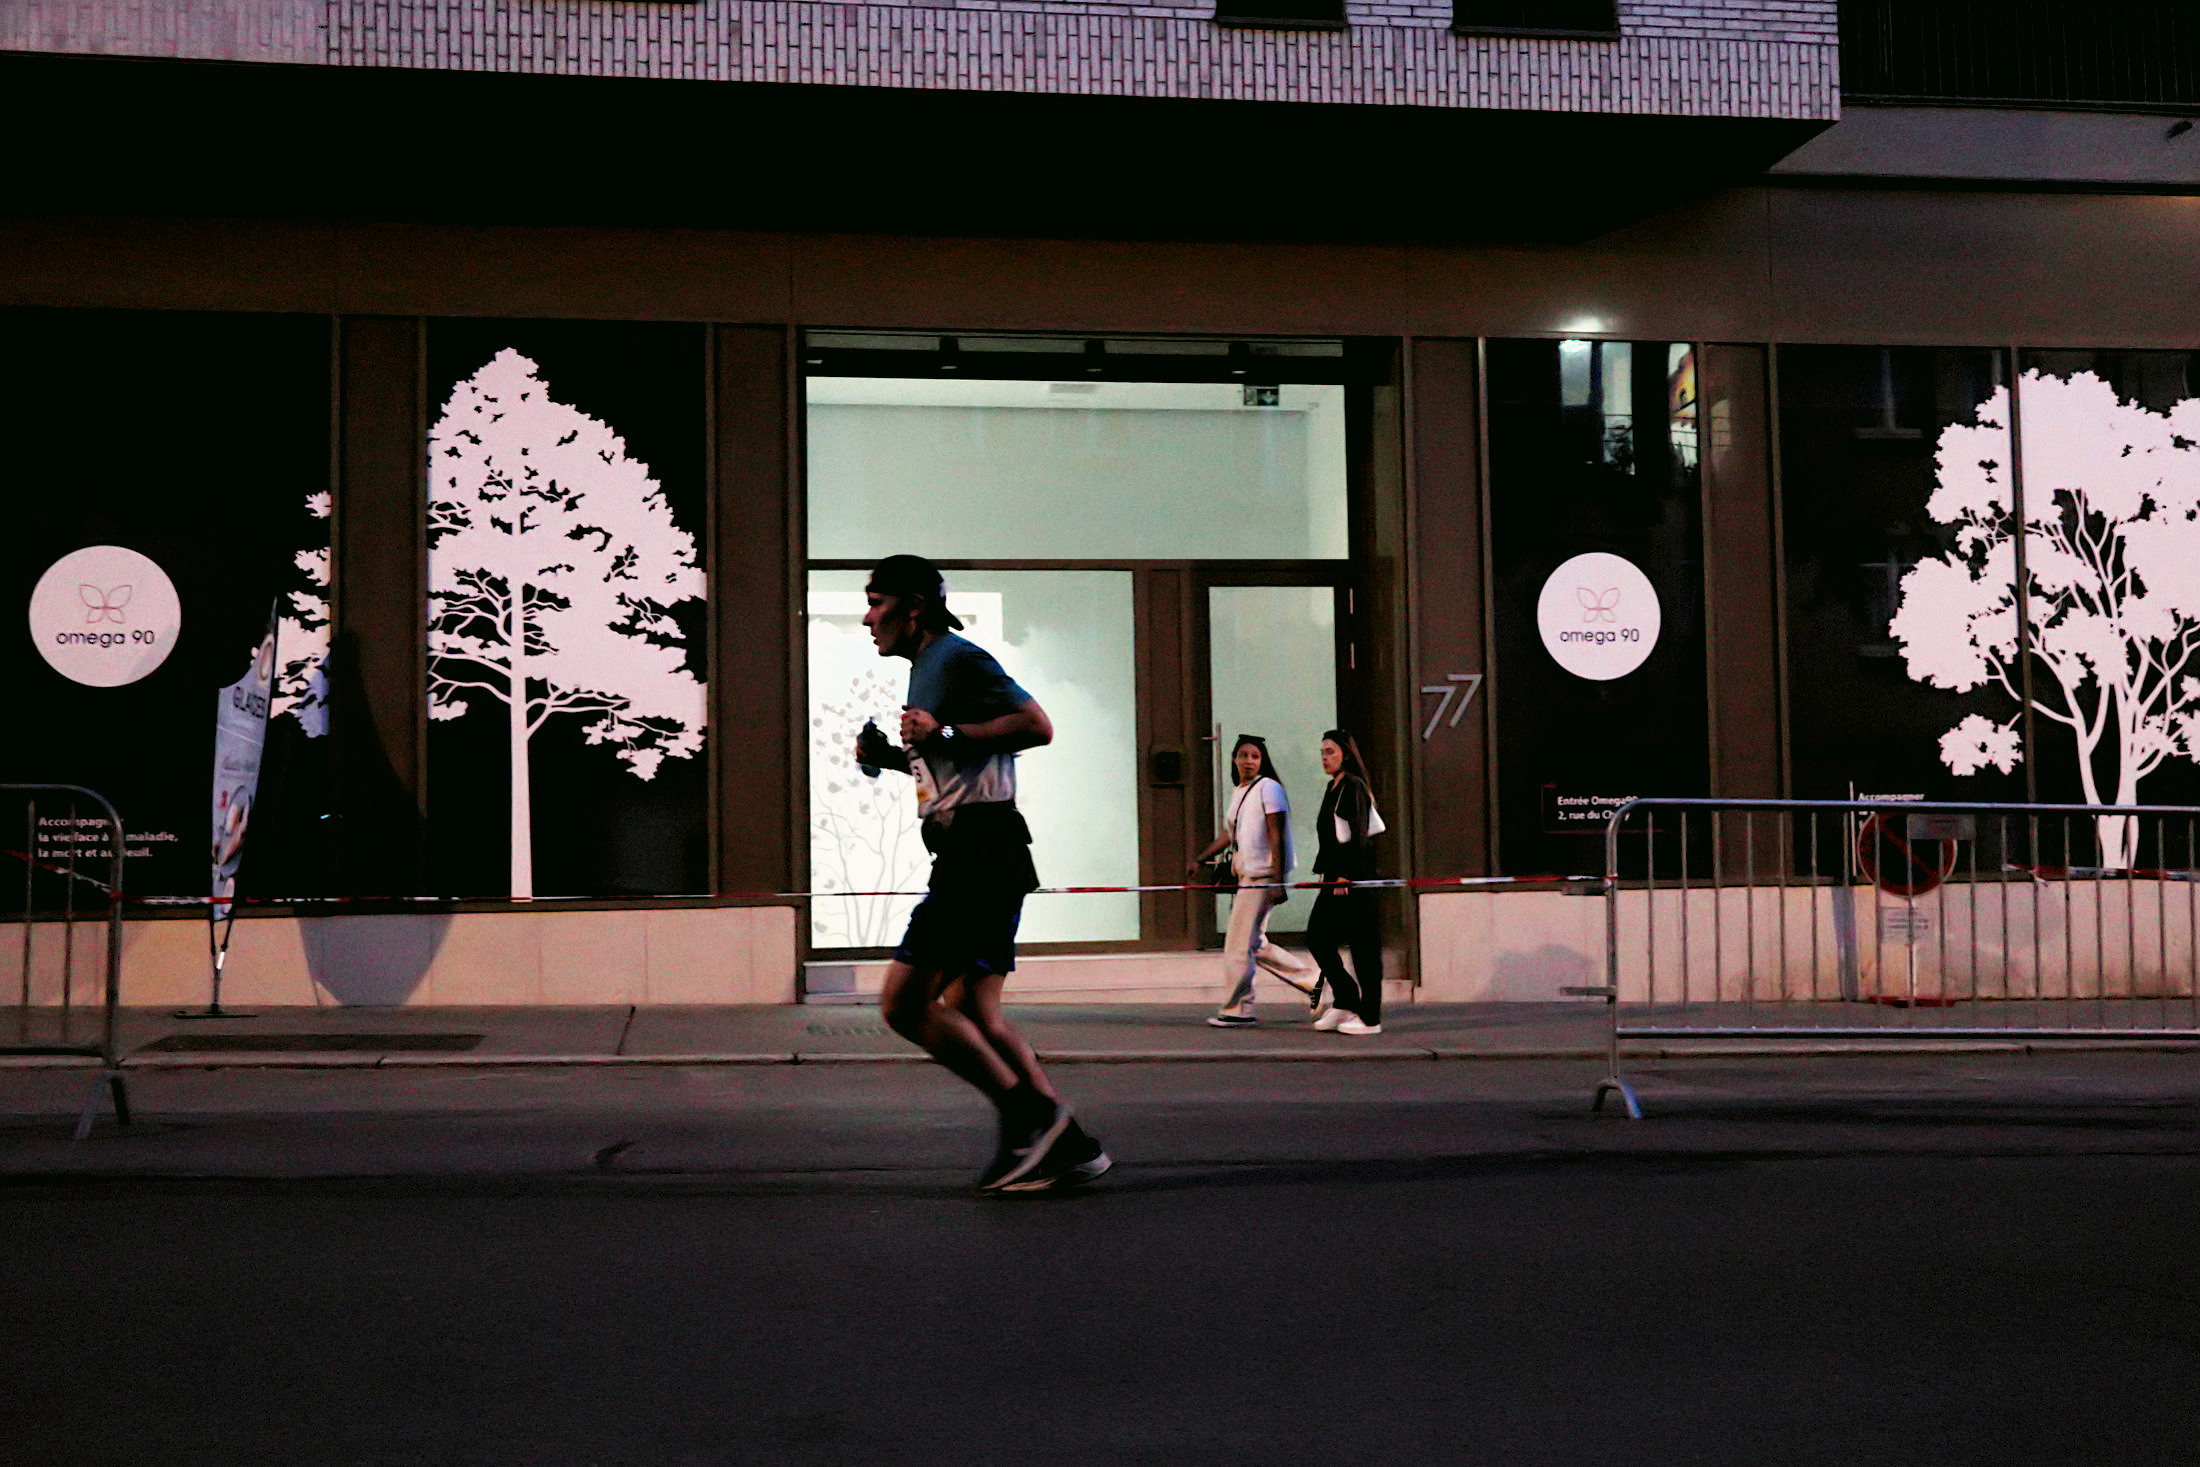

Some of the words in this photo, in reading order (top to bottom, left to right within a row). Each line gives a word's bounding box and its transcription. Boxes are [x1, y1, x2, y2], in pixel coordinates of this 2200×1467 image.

[56, 632, 125, 648] omega
[131, 630, 155, 644] 90
[1559, 631, 1616, 645] omega
[1620, 628, 1640, 642] 90
[1421, 674, 1483, 739] 77
[1557, 796, 1589, 806] Entrée
[1558, 811, 1567, 820] 2,
[1569, 812, 1585, 820] rue
[1587, 810, 1600, 819] du
[38, 832, 50, 842] la
[38, 847, 50, 857] la
[52, 848, 82, 857] mot
[85, 848, 97, 857] et
